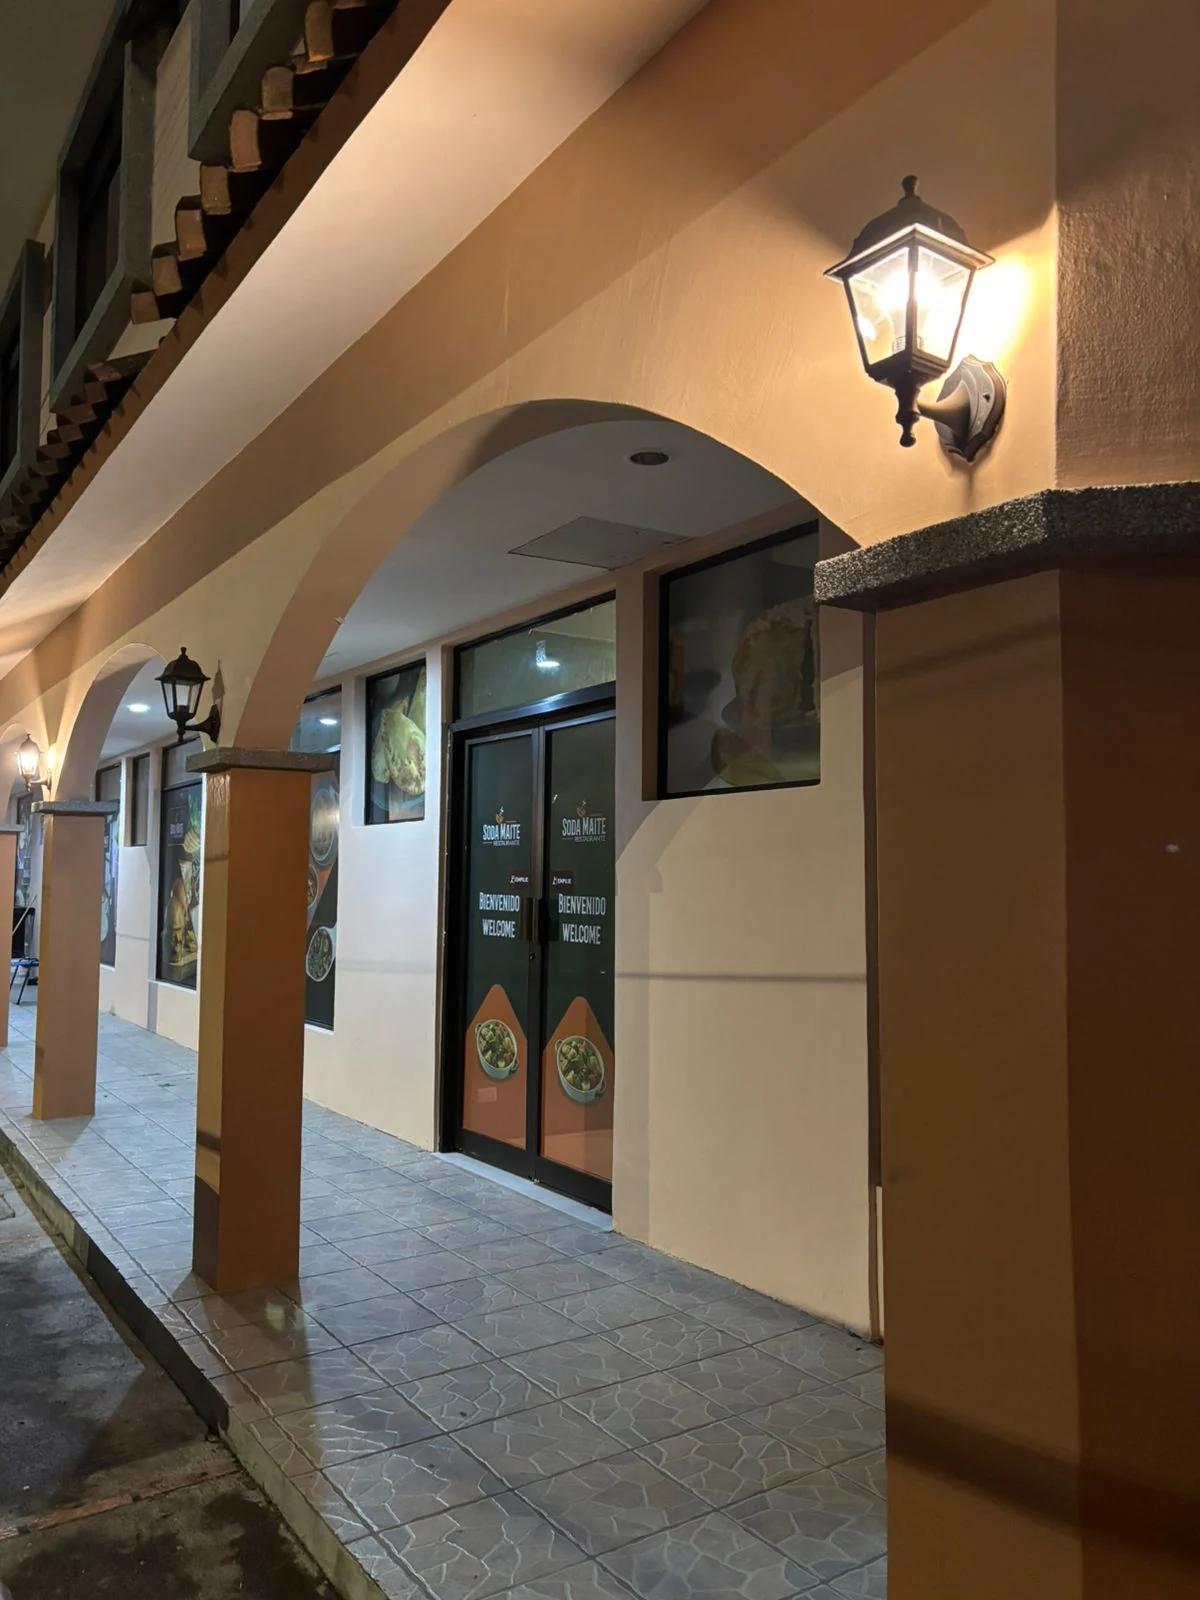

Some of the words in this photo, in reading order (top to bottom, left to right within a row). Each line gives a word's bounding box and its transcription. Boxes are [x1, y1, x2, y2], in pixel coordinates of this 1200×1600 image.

[482, 824, 499, 840] SODA
[500, 823, 521, 840] MAITE
[562, 818, 581, 837] SODA
[582, 816, 607, 836] MAITE
[479, 892, 521, 912] BIENVENIDO
[558, 893, 606, 916] BIENVENIDO
[482, 918, 516, 938] WELCOME
[562, 923, 601, 945] WELCOME
